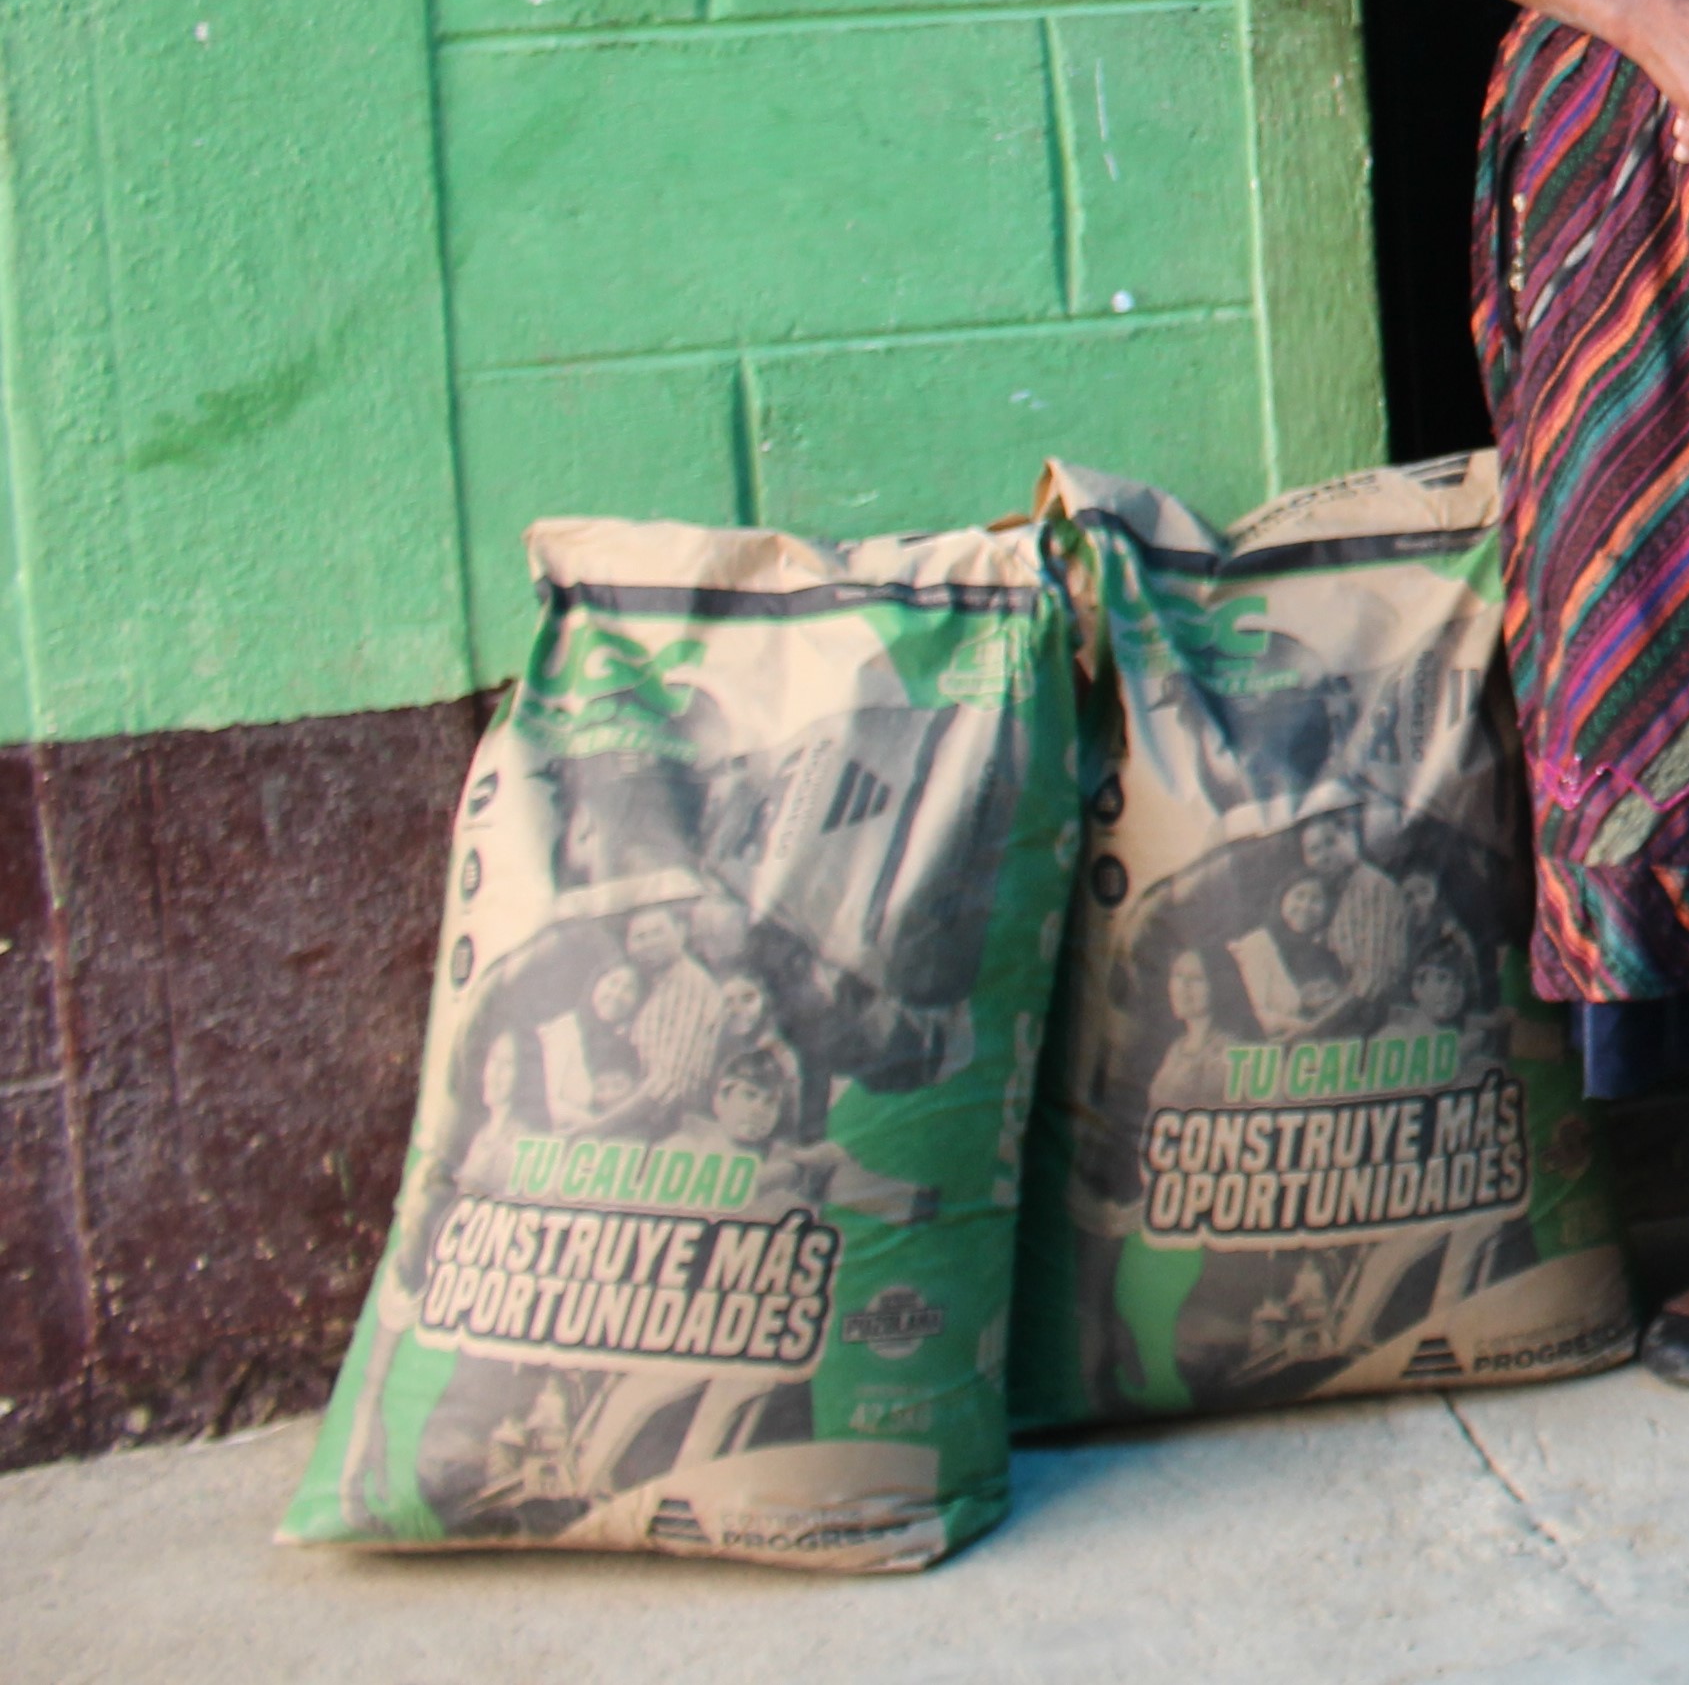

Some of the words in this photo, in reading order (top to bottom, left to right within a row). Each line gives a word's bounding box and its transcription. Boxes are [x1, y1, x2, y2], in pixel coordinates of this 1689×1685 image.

[1227, 1046, 1279, 1100] TU
[1287, 1031, 1459, 1096] CALIDAD
[1149, 1101, 1424, 1173] CONSTRUYE
[1432, 1073, 1521, 1155] MÁS
[510, 1140, 559, 1194] TU
[562, 1144, 758, 1207] CALIDAD
[1150, 1143, 1523, 1229] OPORTUNIDADES
[437, 1201, 699, 1287] CONSTRUYE
[703, 1215, 833, 1296] MÁS
[425, 1263, 823, 1360] OPORTUNIDADES
